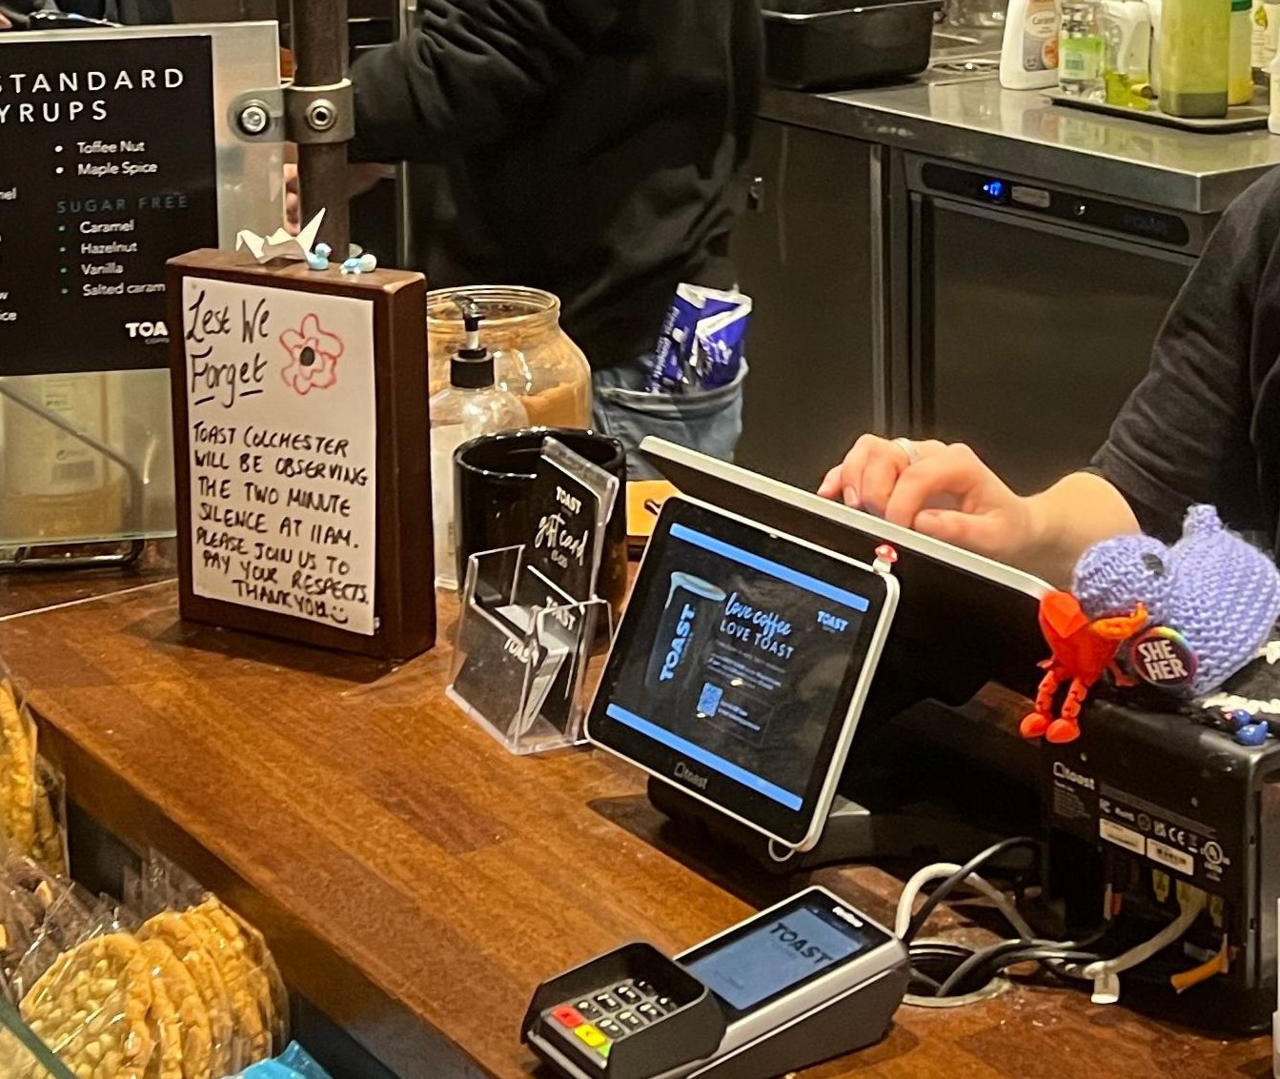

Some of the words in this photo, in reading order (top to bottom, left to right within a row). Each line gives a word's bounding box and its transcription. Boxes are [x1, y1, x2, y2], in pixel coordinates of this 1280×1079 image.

[77, 140, 118, 154] Toffee
[120, 138, 145, 153] Nut
[77, 163, 120, 178] Maple
[121, 161, 158, 176] Spice
[56, 198, 127, 215] SUGAR
[138, 195, 188, 210] FREE
[80, 219, 135, 234] Caramel
[81, 241, 138, 255] Hazelnut
[81, 262, 124, 276] Vanilla
[82, 282, 125, 297] Salted
[187, 290, 231, 344] Lest
[241, 297, 271, 344] We
[190, 346, 269, 408] Forget
[193, 421, 237, 445] TOAST
[242, 425, 350, 458] COLCHESTER
[194, 449, 230, 471] WILL
[239, 452, 263, 474] BE
[275, 457, 369, 487] OBSERVING
[198, 475, 232, 500] THE
[244, 481, 279, 506] TWO
[287, 487, 351, 518] MINUTE
[199, 502, 269, 534] SILENCE
[279, 518, 302, 539] AT
[196, 525, 249, 556] PLEASE
[254, 541, 293, 565] JOIN
[297, 549, 317, 570] US
[326, 555, 350, 576] TO
[202, 549, 231, 575] PAY
[239, 559, 278, 585] YOUR
[232, 578, 294, 609] THANK
[752, 607, 792, 637] coffee
[816, 610, 849, 632] TOAST
[659, 603, 696, 681] TOAST
[720, 619, 750, 643] LOVE
[754, 633, 795, 659] TOAST
[1138, 640, 1175, 664] SHE
[1145, 658, 1187, 682] HER
[769, 922, 834, 965] TOAST
